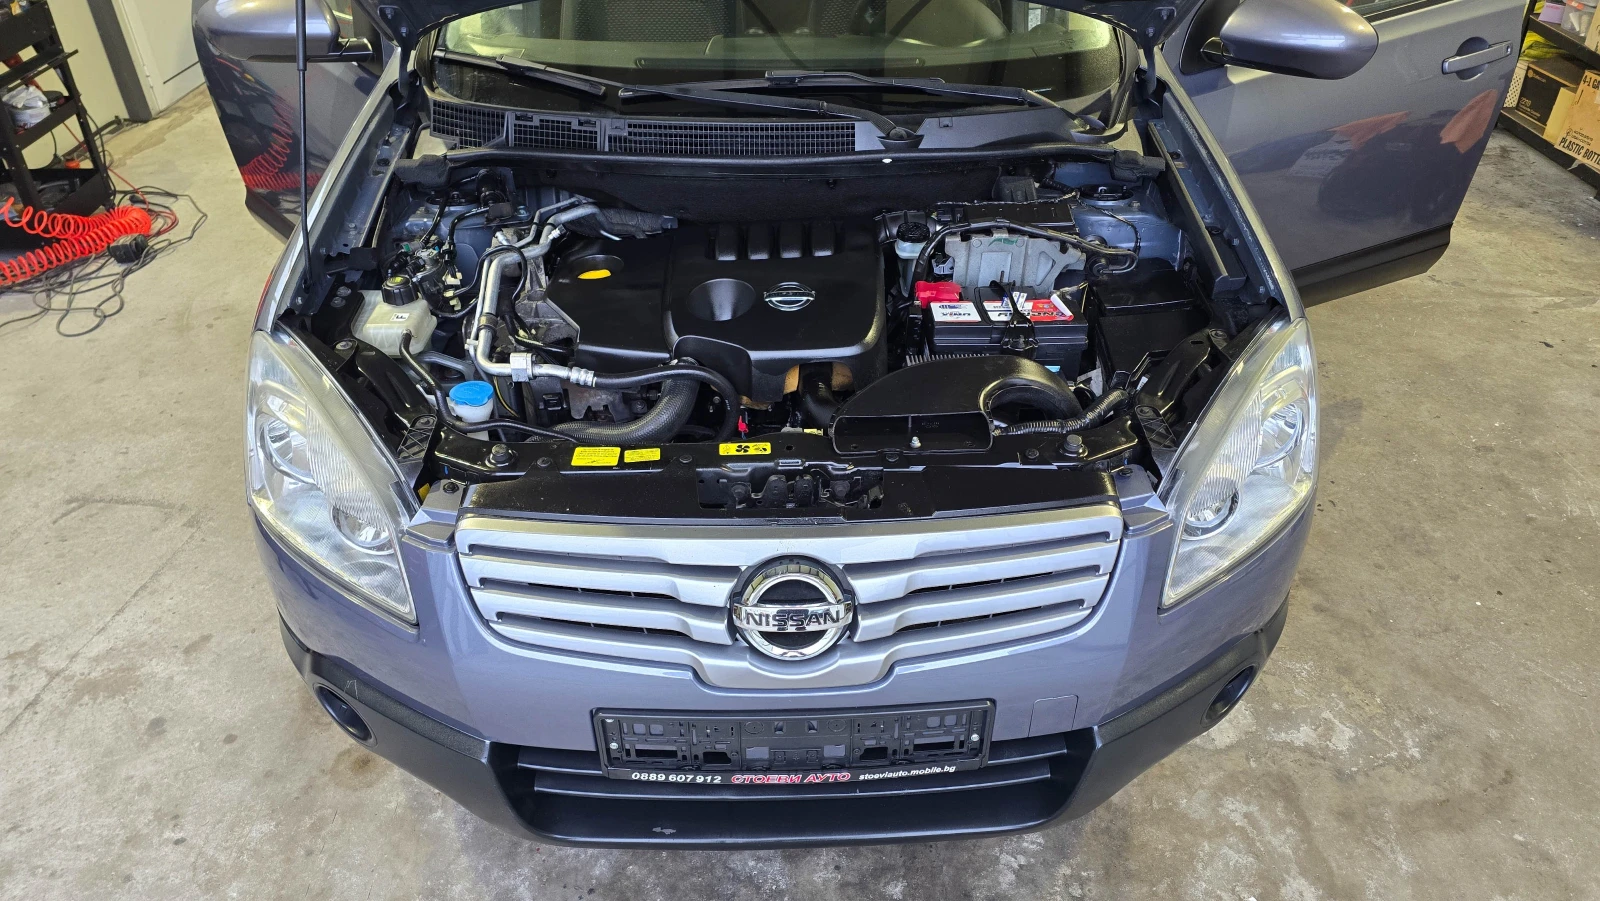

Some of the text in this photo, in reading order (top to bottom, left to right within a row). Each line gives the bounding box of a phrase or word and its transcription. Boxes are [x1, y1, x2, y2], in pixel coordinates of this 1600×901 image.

[1558, 137, 1585, 156] PLASTIC
[745, 609, 840, 627] NISSAN
[631, 772, 722, 783] 0889 607 912
[731, 772, 851, 784] СТОЕВИ АУТО
[858, 765, 957, 780] stoeviauto.mobile.bg
